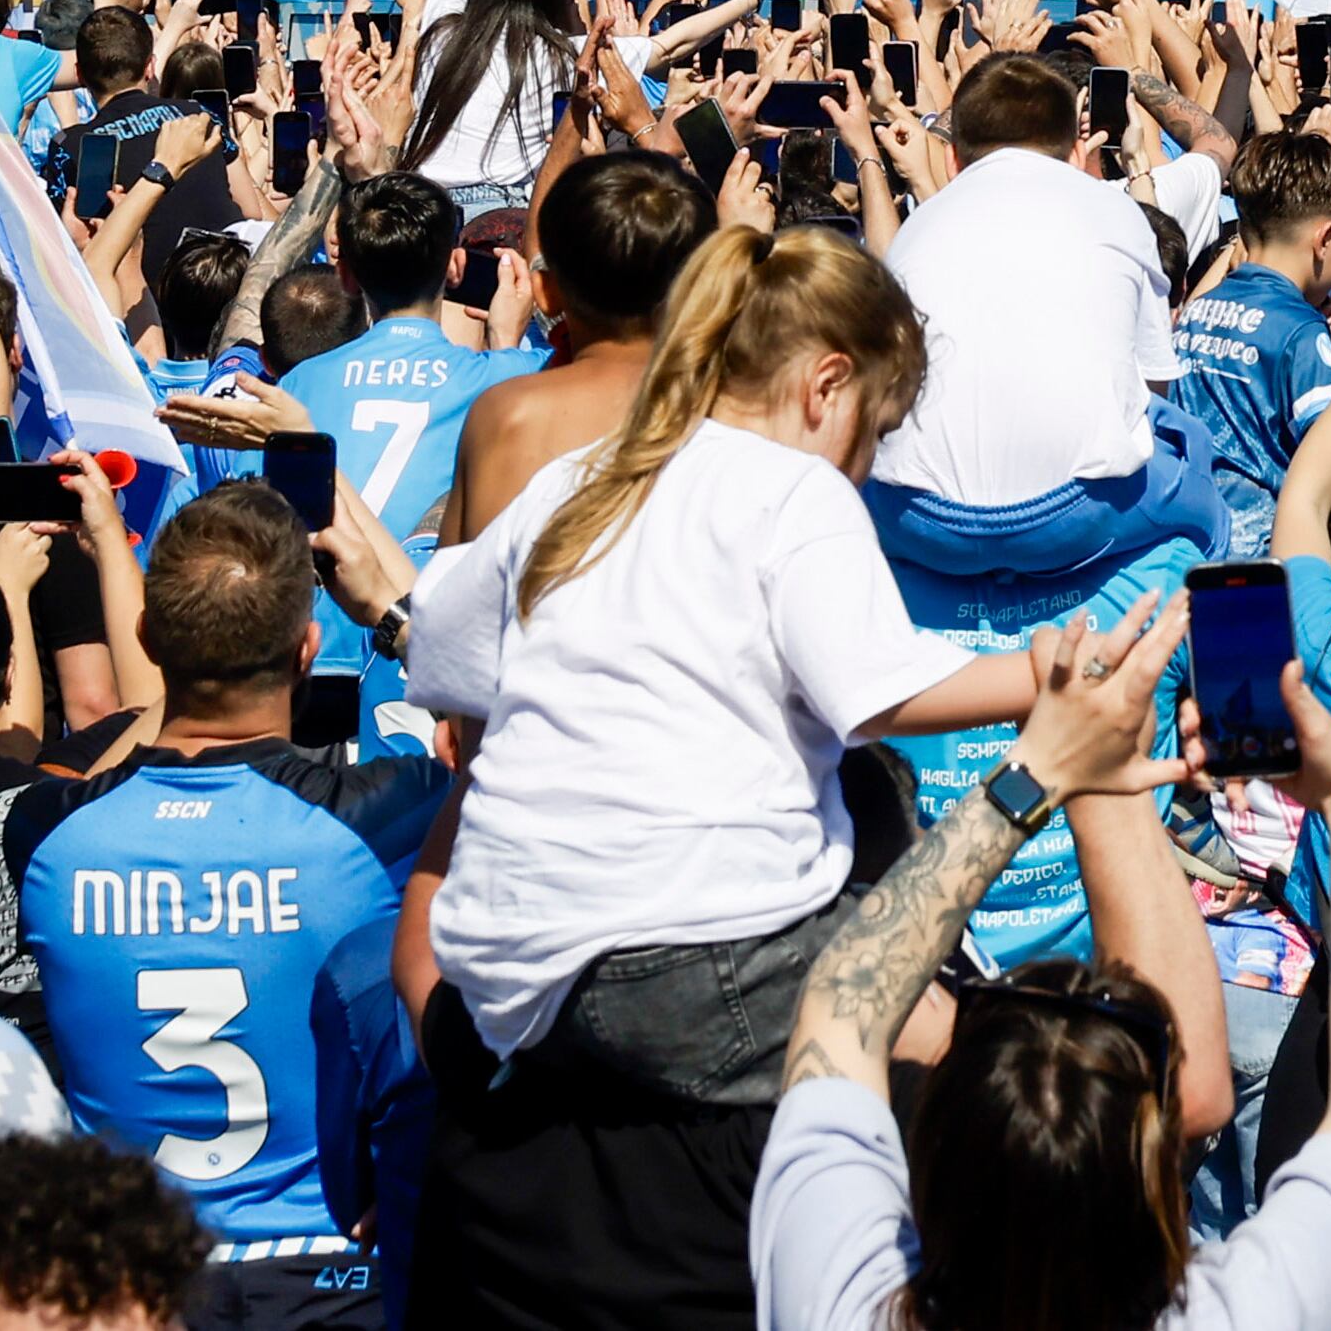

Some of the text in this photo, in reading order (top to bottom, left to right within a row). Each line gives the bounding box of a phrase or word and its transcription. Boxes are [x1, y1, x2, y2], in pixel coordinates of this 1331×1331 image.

[343, 357, 449, 389] NERES
[351, 398, 430, 518] 7
[154, 800, 213, 820] SSCN
[72, 867, 301, 936] MINJAE
[136, 967, 269, 1182] 3
